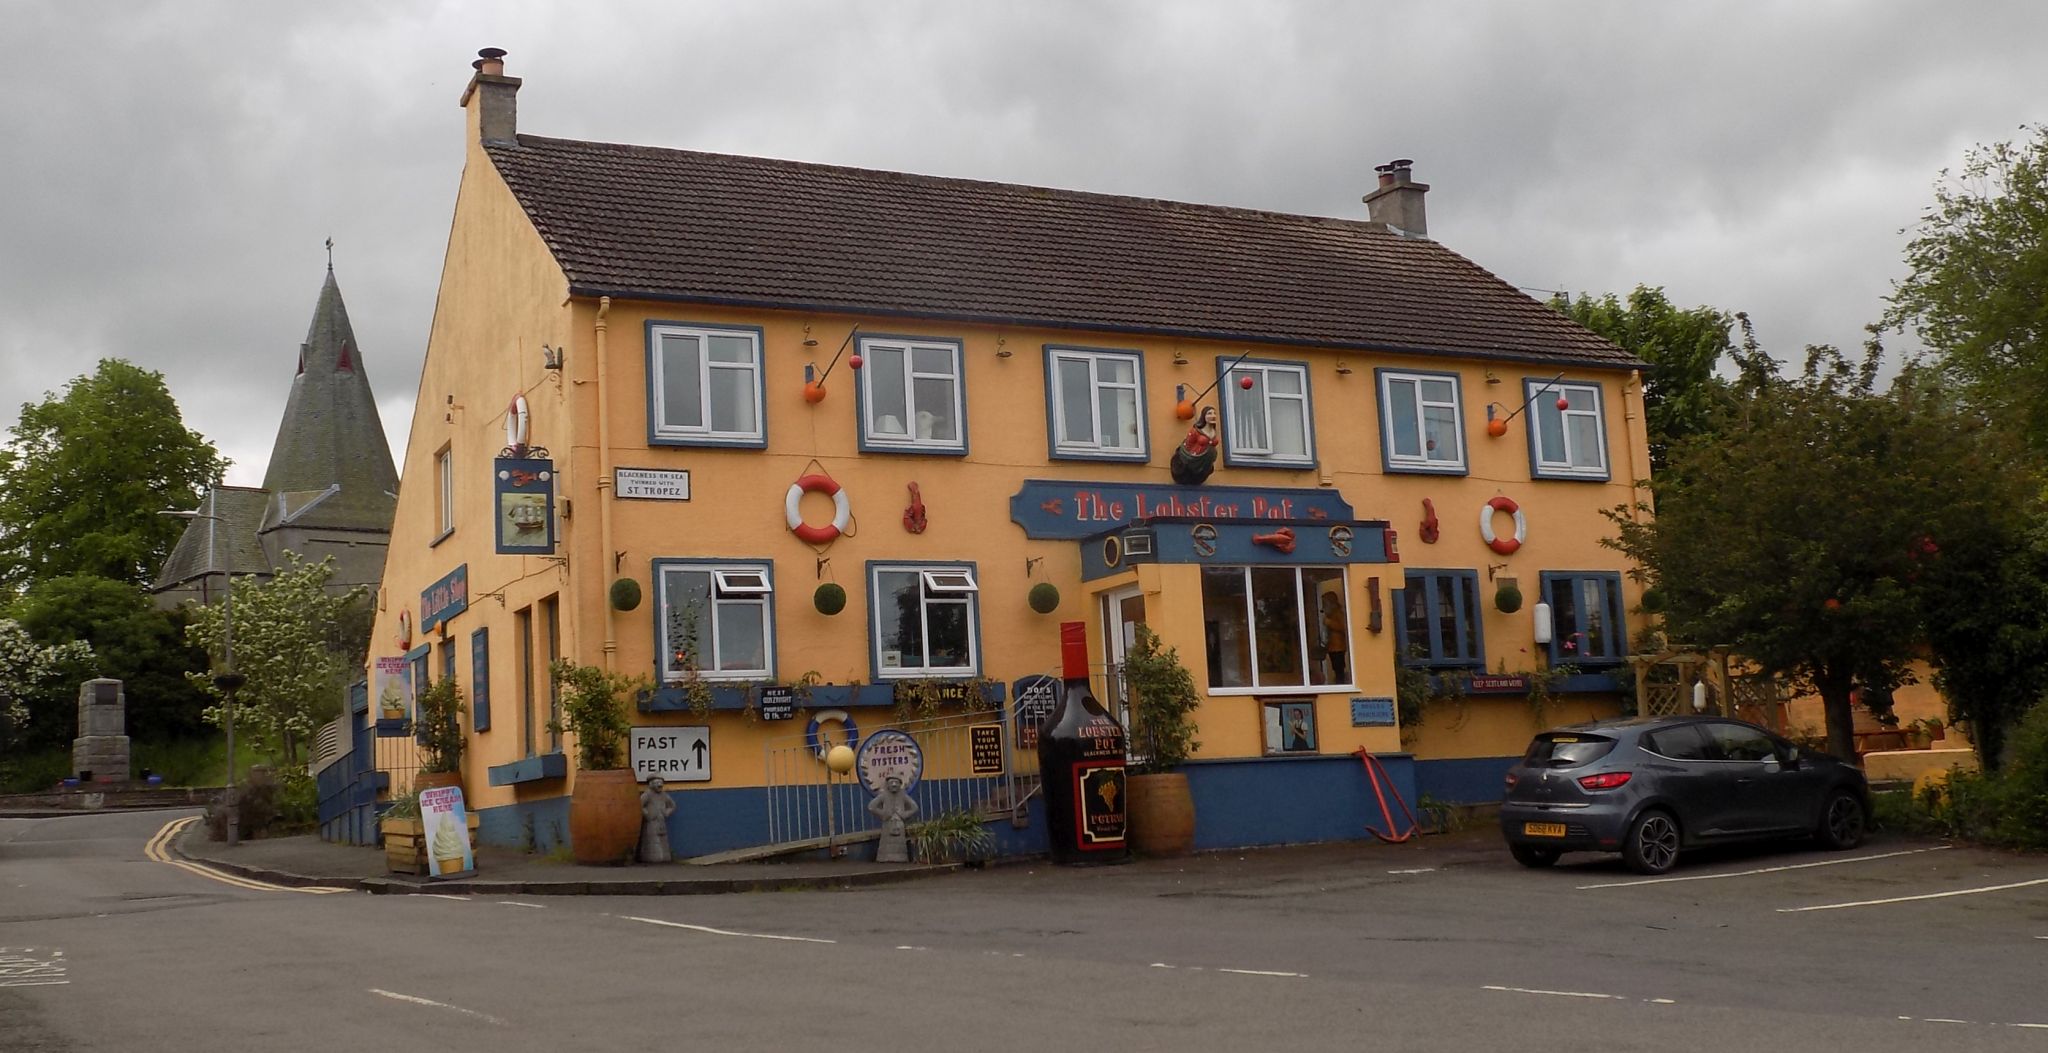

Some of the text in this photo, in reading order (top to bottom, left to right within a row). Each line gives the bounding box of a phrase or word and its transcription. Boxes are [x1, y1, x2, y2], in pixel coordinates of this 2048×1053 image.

[618, 471, 657, 479] BLACKNESS
[644, 487, 681, 496] TROPEZ
[1072, 490, 1124, 521] The
[1251, 495, 1297, 520] Pot
[637, 736, 678, 750] FAST
[1094, 738, 1116, 750] POT
[874, 745, 906, 755] FRESH
[987, 750, 1000, 758] THE
[638, 759, 690, 773] FERRY
[871, 756, 909, 767] OYSTERS
[973, 758, 1000, 766] BOTTLE
[421, 795, 462, 808] ICE CREAM
